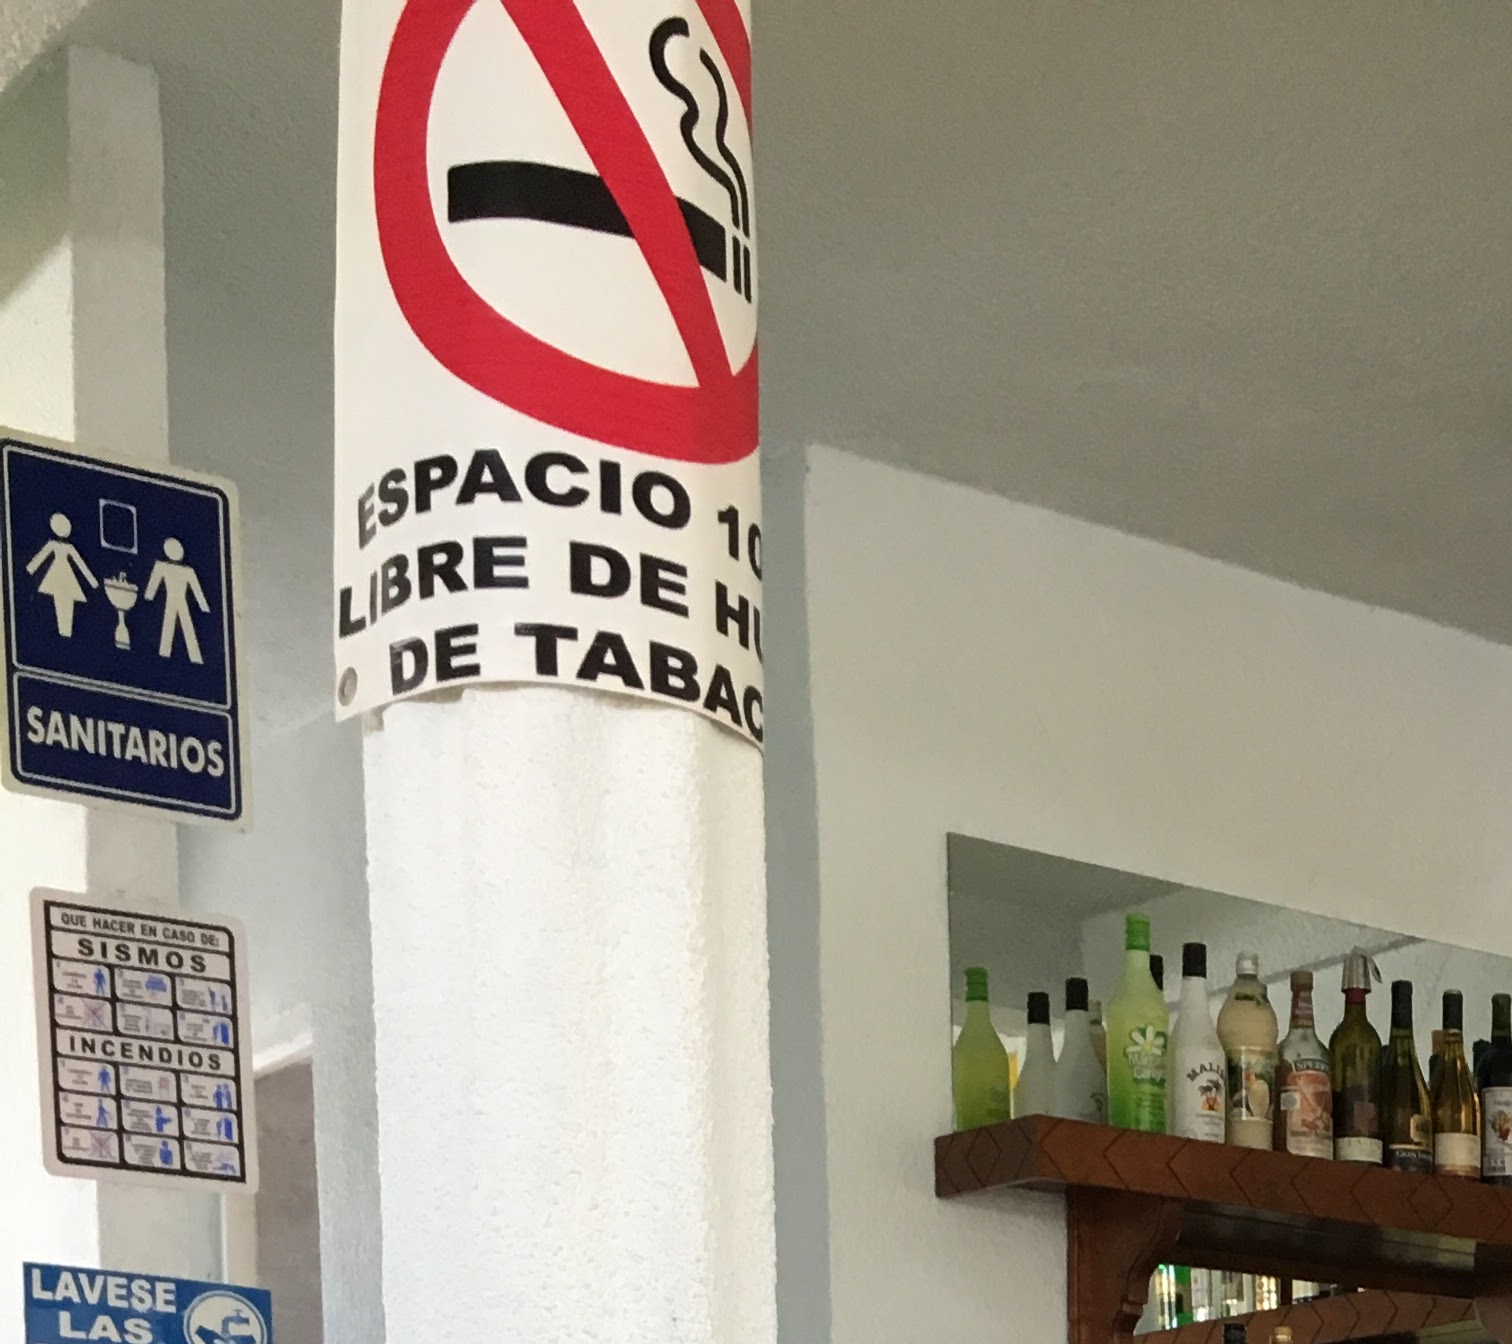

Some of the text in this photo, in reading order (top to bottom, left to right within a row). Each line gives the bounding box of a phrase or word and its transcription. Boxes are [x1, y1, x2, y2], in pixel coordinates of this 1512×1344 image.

[358, 448, 691, 550] ESPACIO
[339, 536, 529, 638] LIBRE
[570, 540, 690, 618] DE
[389, 623, 481, 695] DE
[27, 705, 224, 777] SANITARIOS
[61, 911, 87, 928] QUE
[93, 918, 135, 935] HACER
[140, 924, 157, 938] EN
[163, 927, 195, 944] CASO
[77, 937, 207, 973] SISMOS
[70, 1035, 221, 1070] INCENDIOS
[32, 1268, 177, 1314] LAVESE
[59, 1311, 153, 1344] LAS
